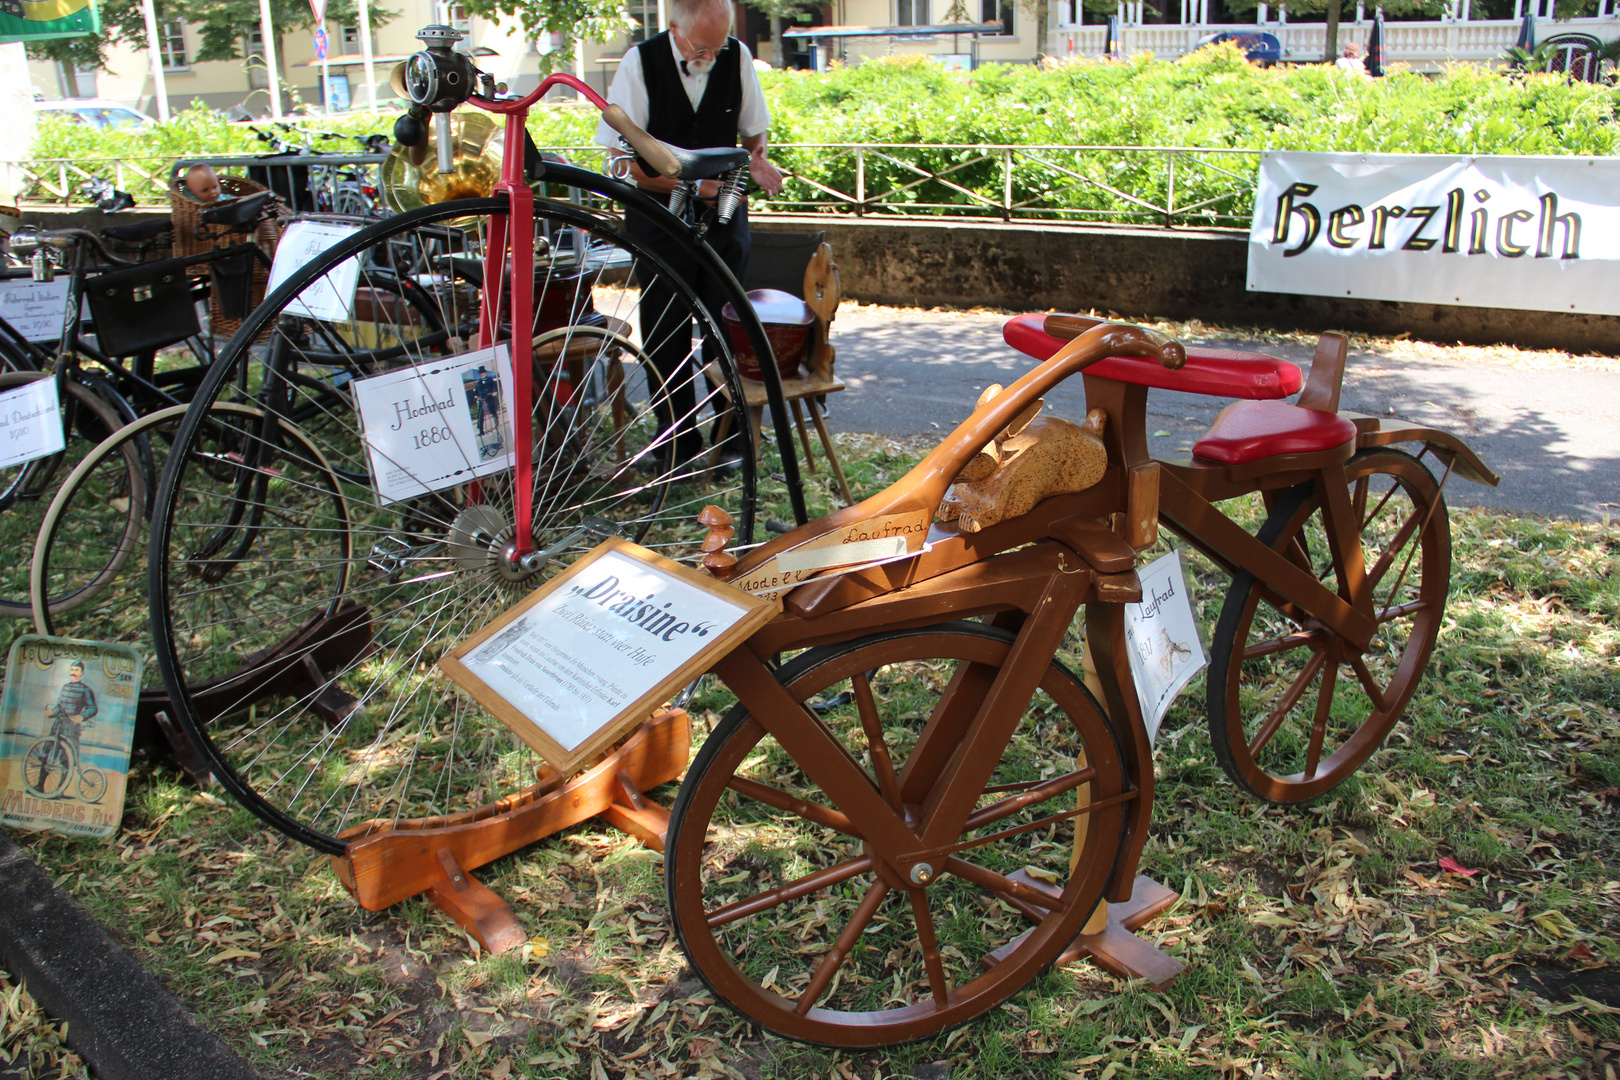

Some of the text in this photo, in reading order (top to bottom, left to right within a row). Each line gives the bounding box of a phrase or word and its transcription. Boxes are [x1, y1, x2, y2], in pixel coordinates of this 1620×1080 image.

[1271, 182, 1582, 260] Herzlich
[391, 388, 456, 431] Hochrad
[413, 426, 452, 450] 1880
[842, 519, 926, 545] Laufrad
[1138, 576, 1175, 622] Laufrad
[552, 604, 575, 621] Zwei
[610, 639, 632, 652] vier
[627, 646, 656, 666] Hufe
[1137, 637, 1153, 666] 1817
[606, 697, 620, 707] Karl
